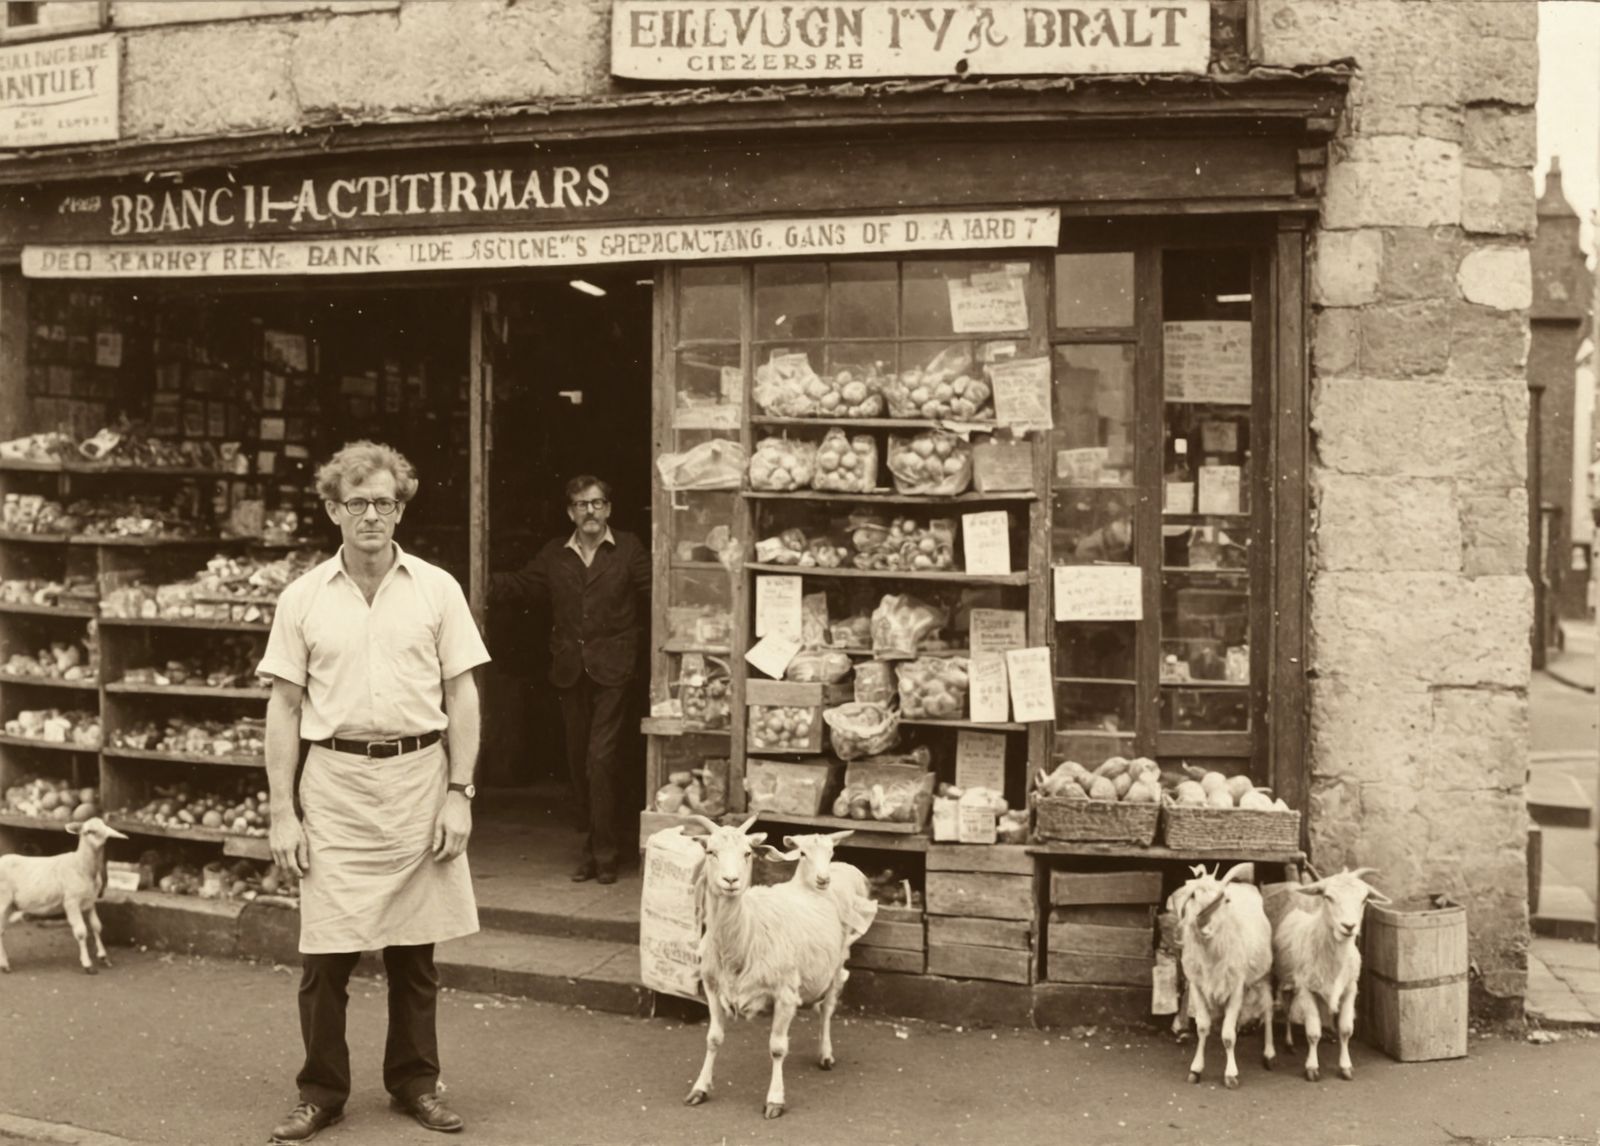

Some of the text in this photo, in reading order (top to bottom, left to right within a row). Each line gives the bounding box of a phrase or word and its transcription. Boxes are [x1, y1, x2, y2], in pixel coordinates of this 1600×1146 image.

[1023, 8, 1187, 48] BRALT
[307, 245, 381, 267] BANK
[785, 224, 846, 249] GANS
[863, 222, 891, 244] OF
